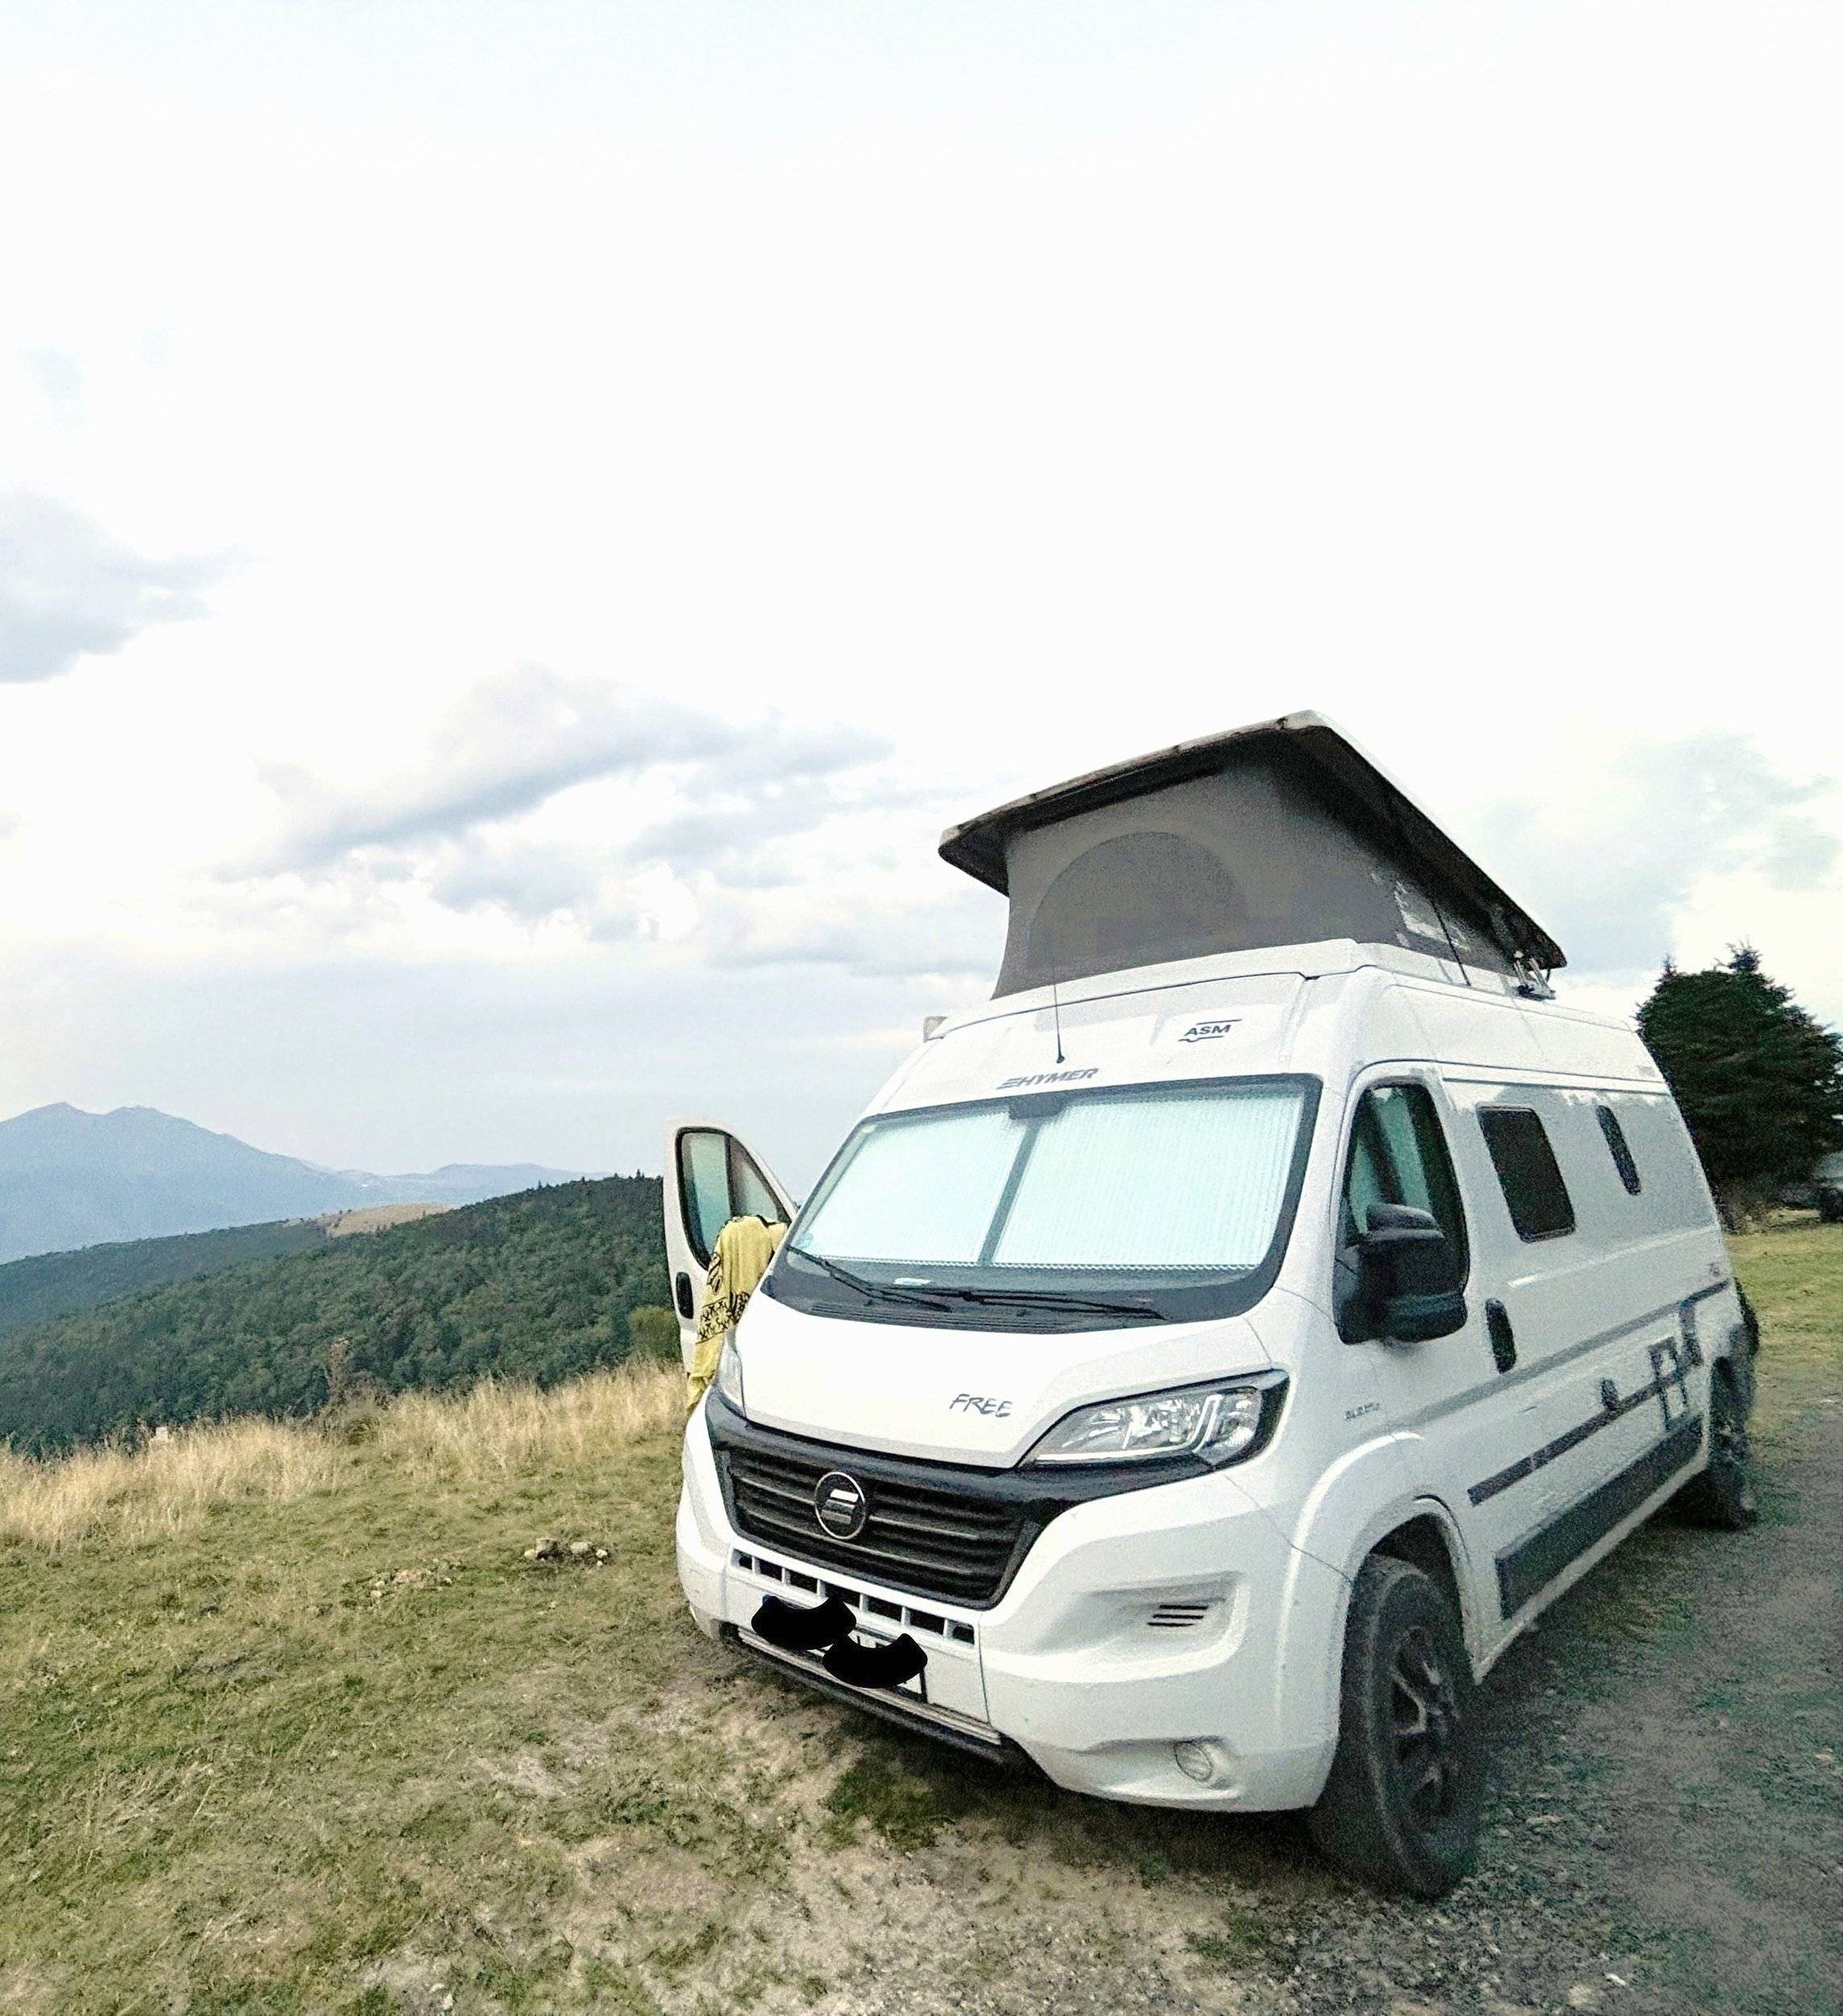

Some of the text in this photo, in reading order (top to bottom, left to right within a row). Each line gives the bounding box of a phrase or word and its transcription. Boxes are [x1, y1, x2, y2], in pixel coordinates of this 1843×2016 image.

[1183, 1023, 1232, 1037] ASM
[1012, 1068, 1099, 1087] HYMER
[949, 1393, 1013, 1418] FREE
